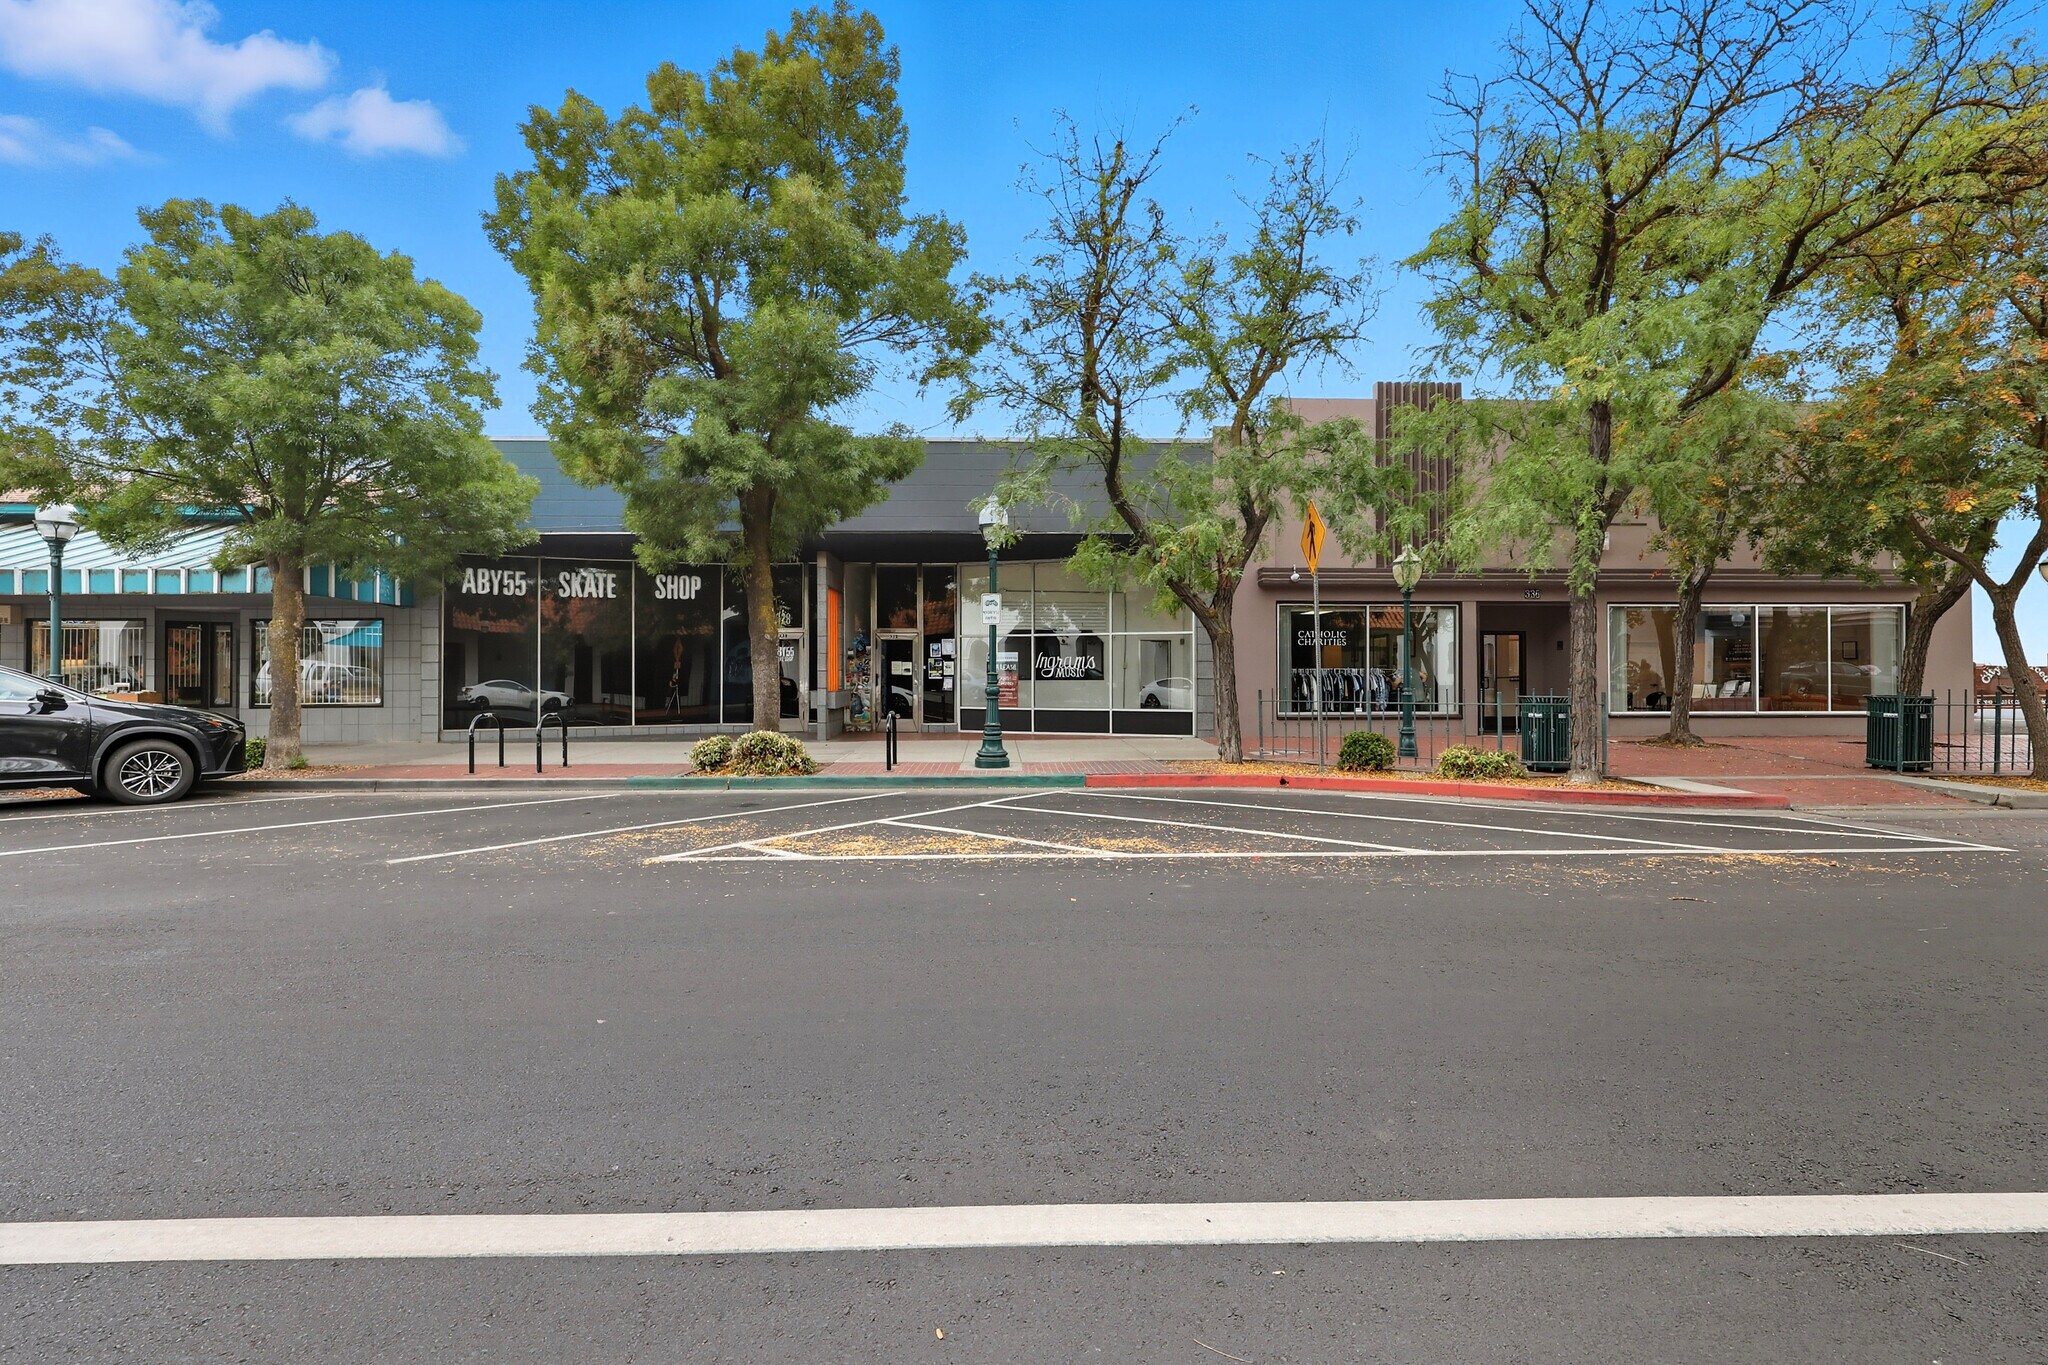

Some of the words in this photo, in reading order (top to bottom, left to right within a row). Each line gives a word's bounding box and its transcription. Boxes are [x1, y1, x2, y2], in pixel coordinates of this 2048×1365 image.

[461, 567, 527, 597] ABY55
[558, 571, 617, 599] SKATE
[655, 574, 702, 601] SHOP
[1035, 651, 1097, 678] Ingram's
[1055, 667, 1086, 678] MUSIC
